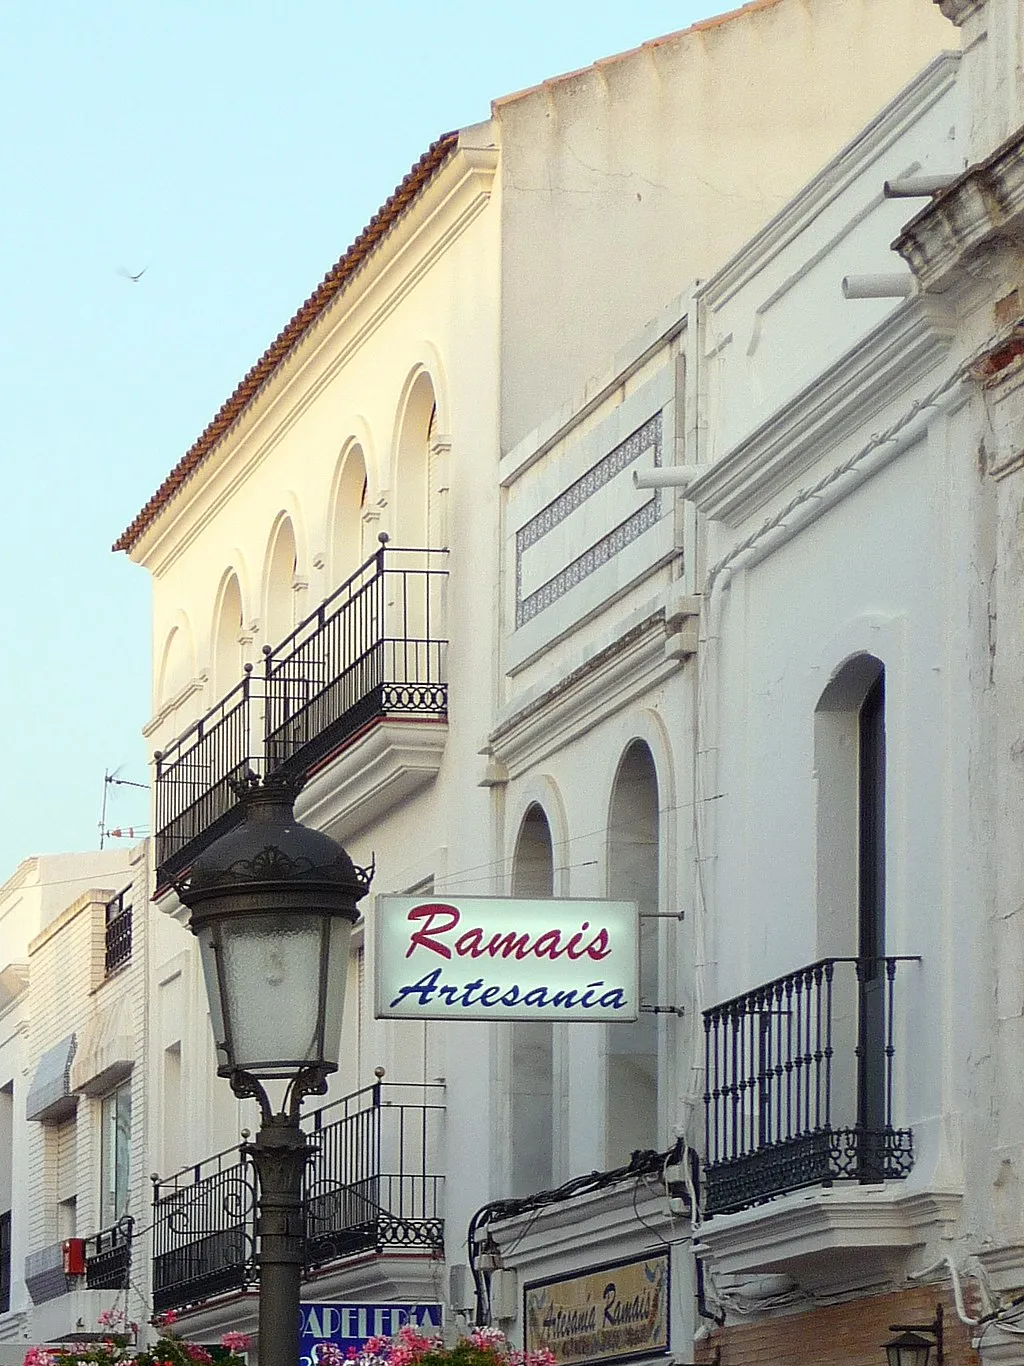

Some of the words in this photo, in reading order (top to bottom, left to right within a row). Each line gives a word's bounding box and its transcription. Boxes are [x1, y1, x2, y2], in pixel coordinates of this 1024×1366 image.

[406, 904, 611, 961] Ramais
[390, 968, 628, 1009] Artesanía
[300, 1306, 442, 1339] APELERÍA
